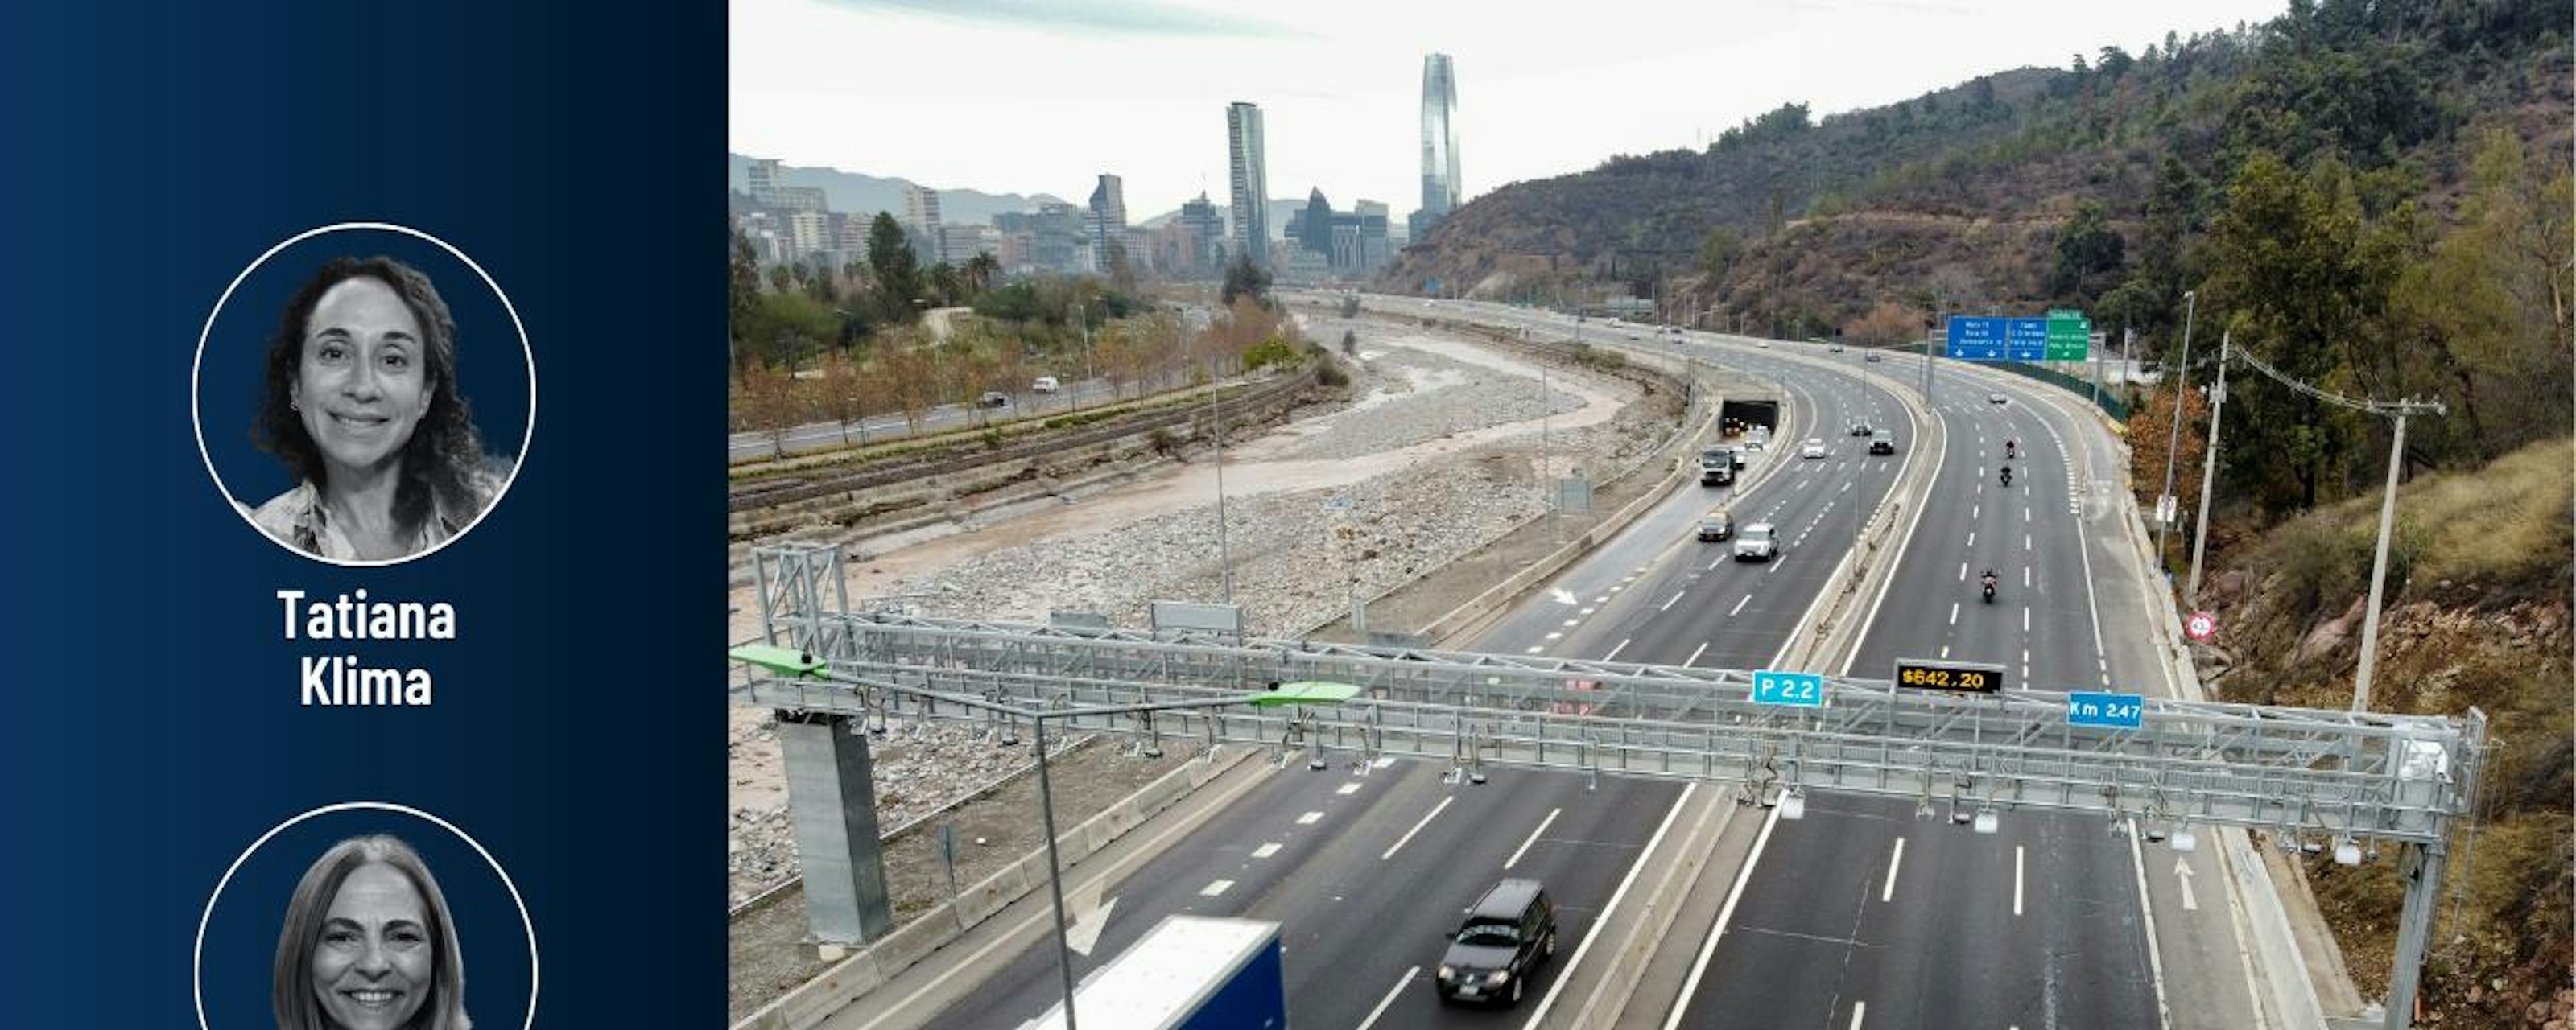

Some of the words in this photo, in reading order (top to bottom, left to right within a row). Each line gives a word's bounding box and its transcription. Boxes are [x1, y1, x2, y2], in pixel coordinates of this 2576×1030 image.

[1761, 678, 1775, 697] P
[1781, 680, 1814, 699] 2.2
[2070, 701, 2099, 717] Km
